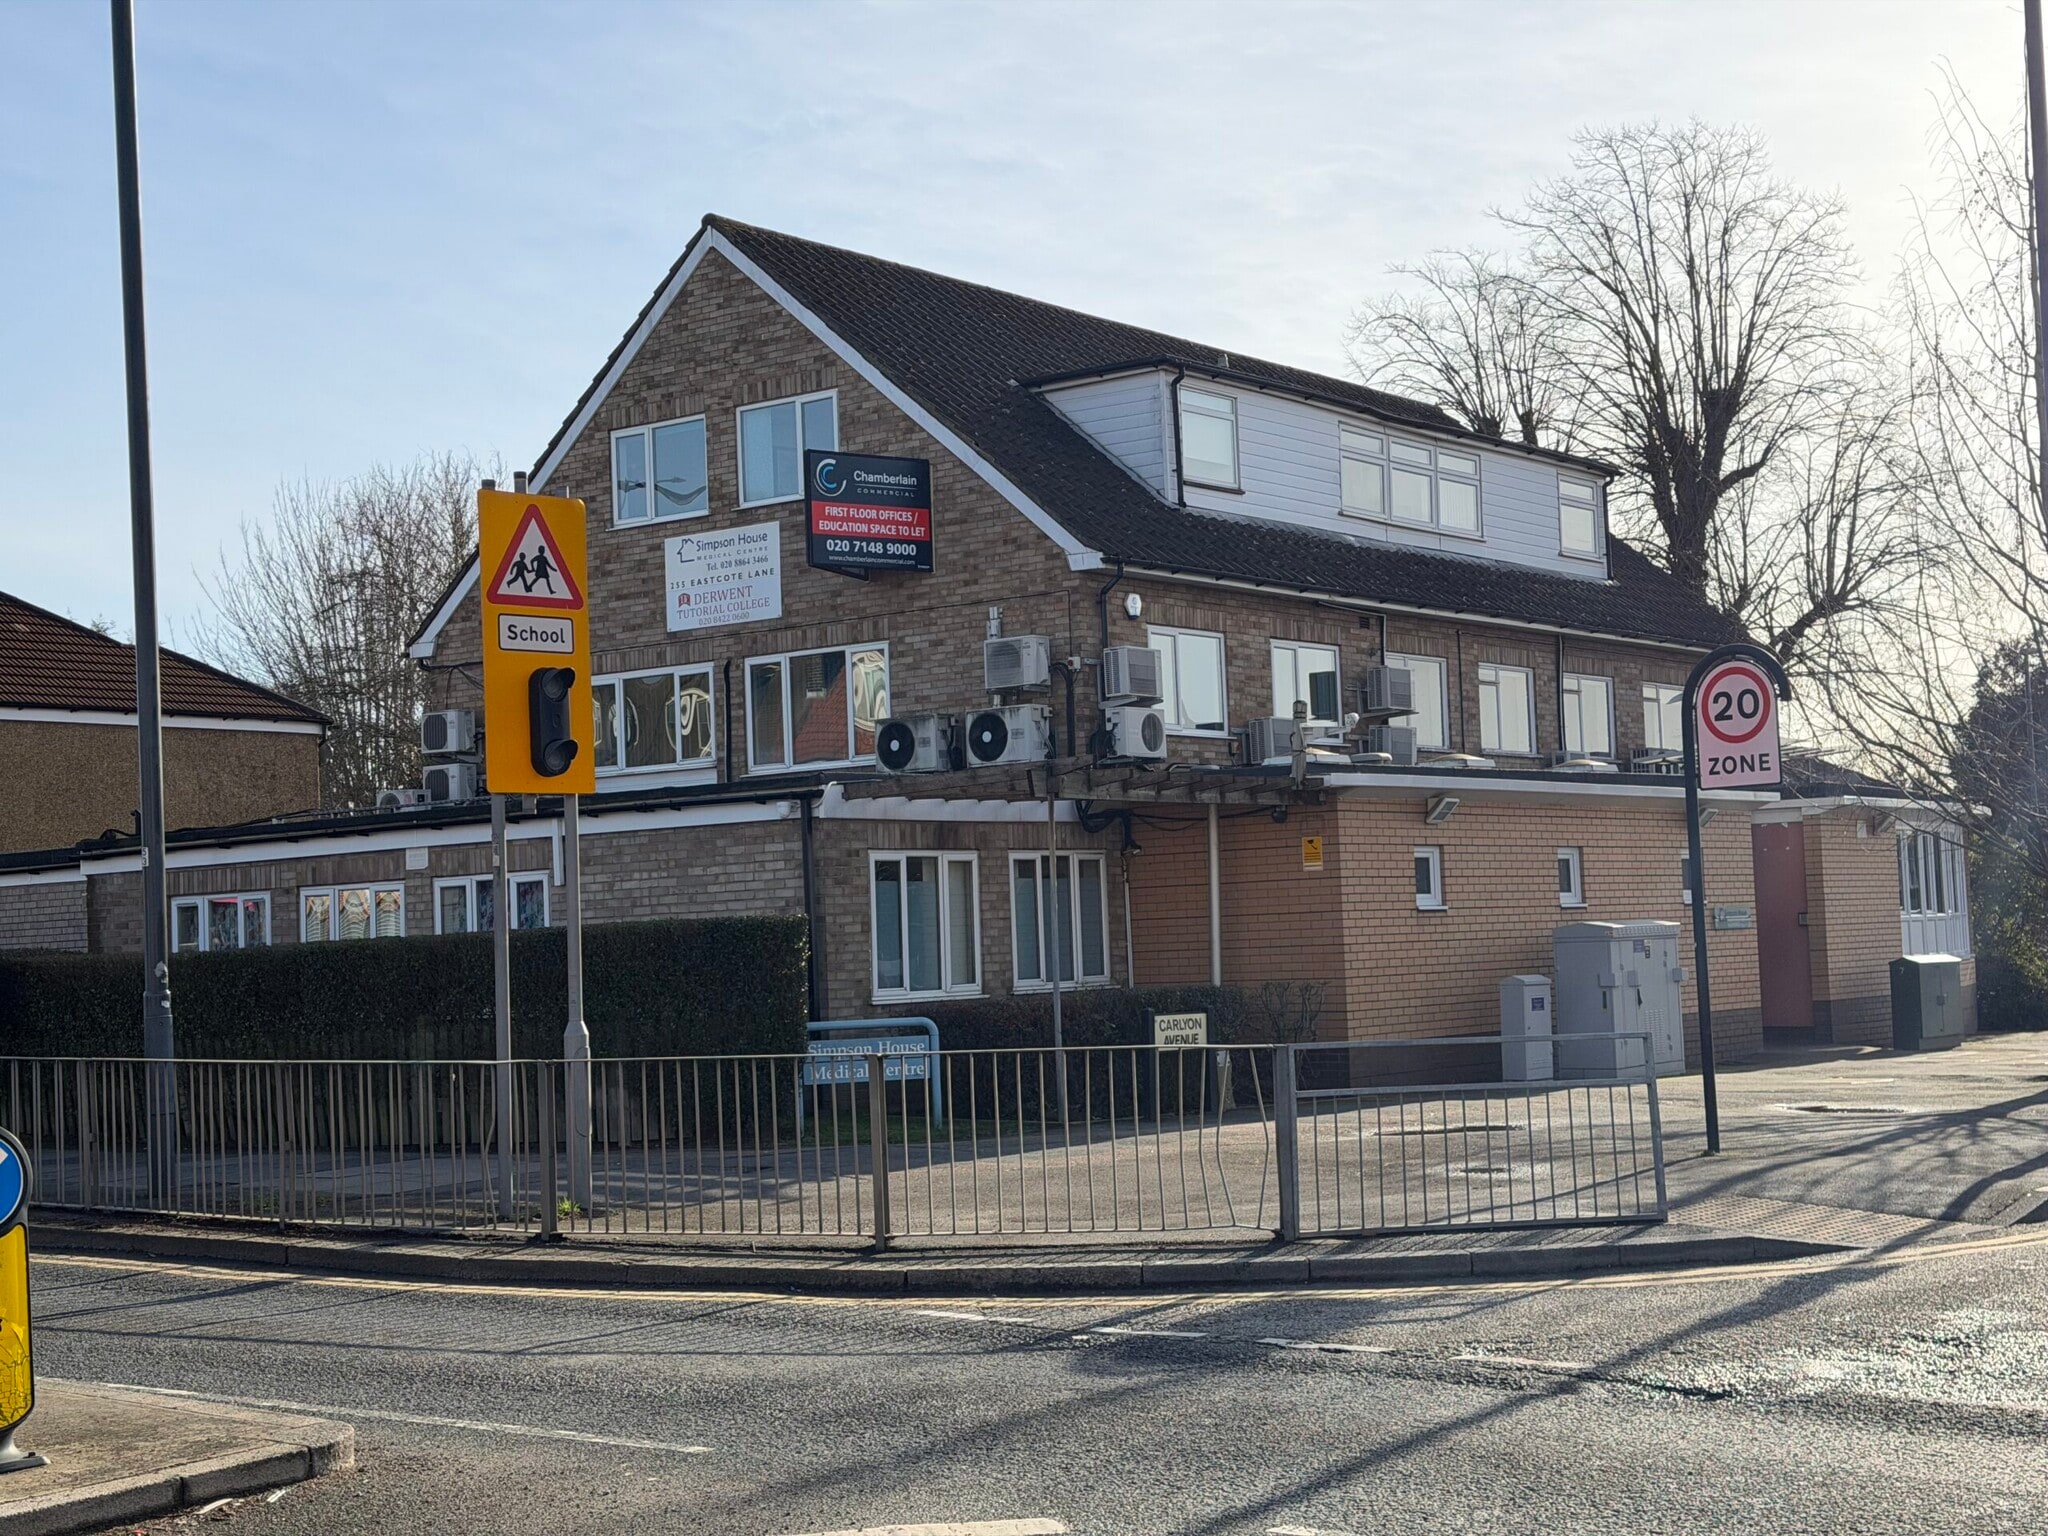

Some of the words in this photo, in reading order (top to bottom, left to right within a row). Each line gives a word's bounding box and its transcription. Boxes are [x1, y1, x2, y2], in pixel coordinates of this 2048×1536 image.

[854, 470, 917, 486] Chamberlain
[856, 488, 915, 498] COMMERCIAL
[825, 506, 847, 516] FIRST
[850, 508, 877, 519] FLOOR
[879, 510, 912, 522] OFFICES
[914, 512, 918, 524] /
[819, 520, 868, 533] EDUCATION
[870, 524, 896, 535] SPACE
[898, 526, 909, 536] TO
[911, 527, 925, 537] LET
[696, 538, 735, 552] Simpson
[738, 532, 768, 546] House
[826, 540, 850, 552] 020
[853, 541, 884, 554] 7148
[886, 544, 916, 555] 9000
[697, 552, 731, 560] MEDICAL
[737, 546, 768, 555] CENTRE
[829, 555, 915, 565] www.chamberlaincommercial.com
[707, 562, 718, 571] Tel.
[720, 560, 732, 569] 020
[734, 558, 750, 568] 8864
[752, 555, 768, 565] 3466
[670, 582, 686, 590] 255
[691, 573, 743, 586] EASTCOTE
[748, 568, 774, 578] LANE
[694, 585, 753, 605] DERWENT
[677, 604, 725, 619] TUTORIAL
[728, 597, 770, 612] COLLEGE
[699, 617, 712, 625] 020
[713, 615, 730, 624] 8422
[732, 612, 750, 622] 0600
[507, 624, 565, 643] School
[1713, 689, 1760, 722] 20
[1708, 753, 1771, 776] ZONE
[1159, 1018, 1202, 1032] CARLYON
[1164, 1033, 1199, 1045] AVENUE
[808, 1044, 872, 1060] Simpson
[878, 1040, 925, 1053] House
[884, 1064, 924, 1076] entre
